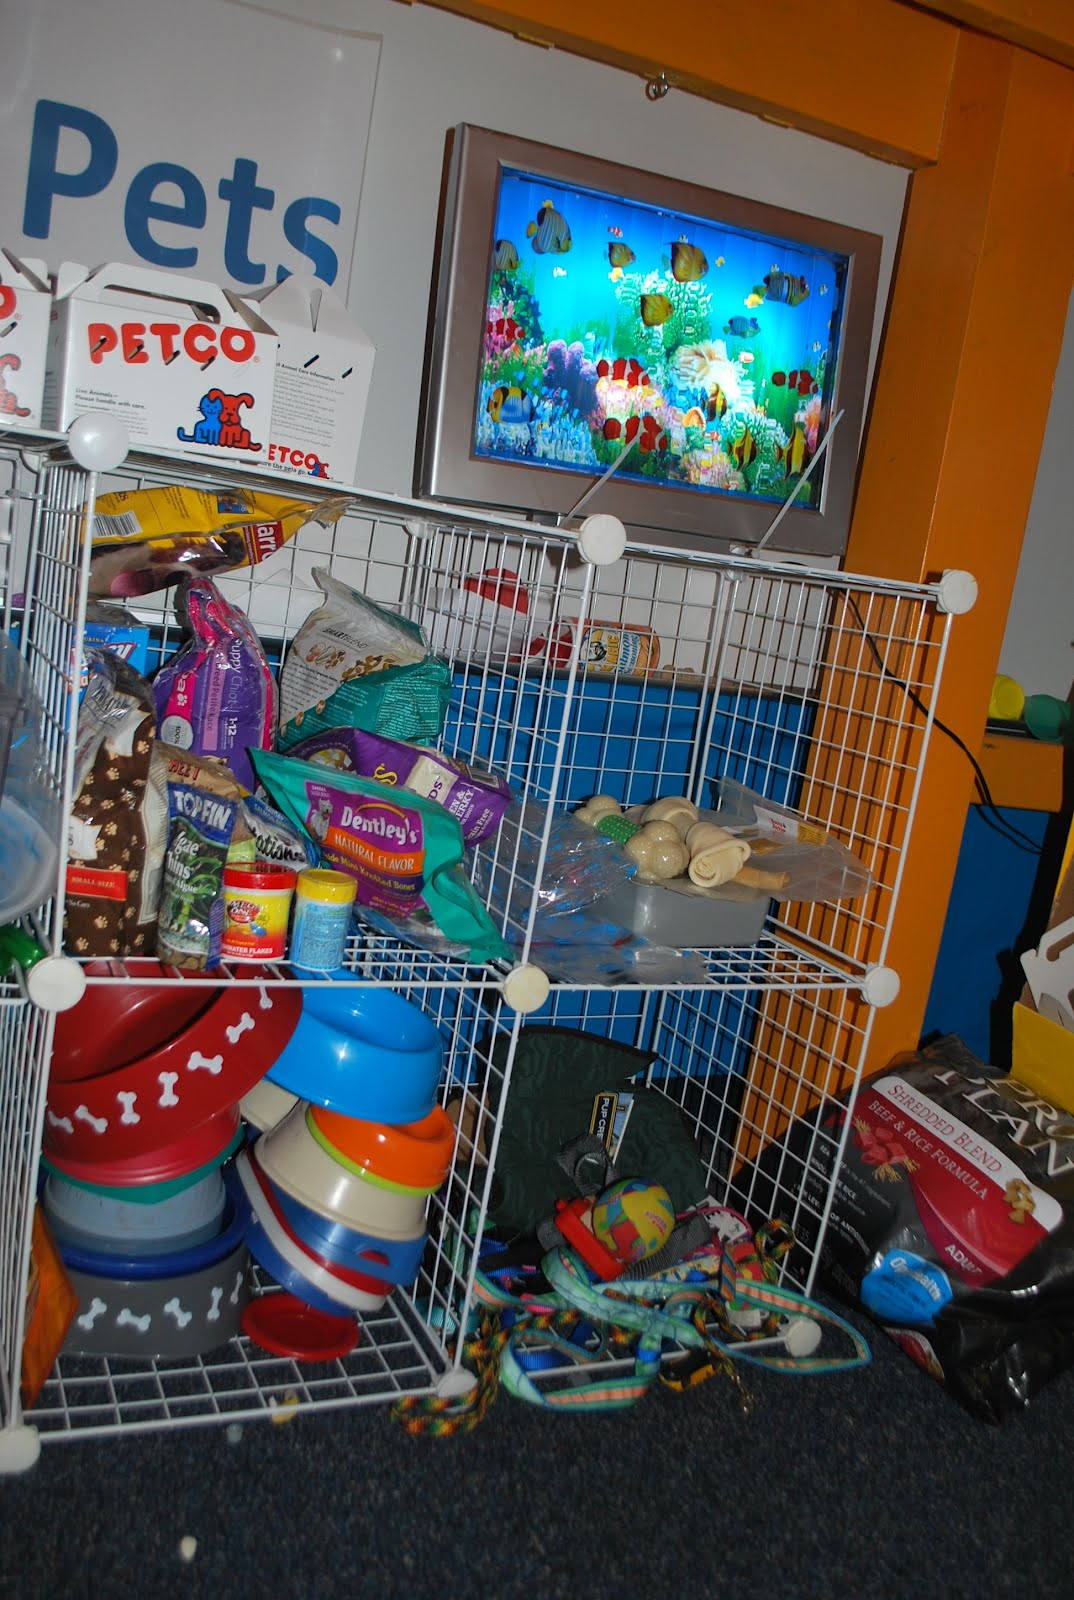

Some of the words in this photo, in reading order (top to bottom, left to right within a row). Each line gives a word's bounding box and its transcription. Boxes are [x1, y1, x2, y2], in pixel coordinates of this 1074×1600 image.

[22, 99, 341, 287] Pets
[87, 323, 256, 364] PETCO
[268, 444, 319, 470] ETCO
[456, 789, 475, 820] ERKY
[341, 805, 418, 845] Dentley's
[464, 821, 480, 840] rain
[176, 831, 200, 857] lgae
[334, 834, 375, 862] NATURAL
[378, 855, 415, 871] FLAVOR
[168, 851, 191, 880] hins
[249, 946, 273, 955] FLAKES
[600, 1096, 611, 1119] PUP
[596, 1119, 606, 1141] CRE
[887, 1084, 956, 1137] SHREDDED
[953, 1131, 1003, 1173] BLEND
[867, 1099, 896, 1122] BEEF
[893, 1120, 905, 1132] &
[904, 1127, 934, 1154] RICE
[931, 1148, 989, 1201] FORMULA
